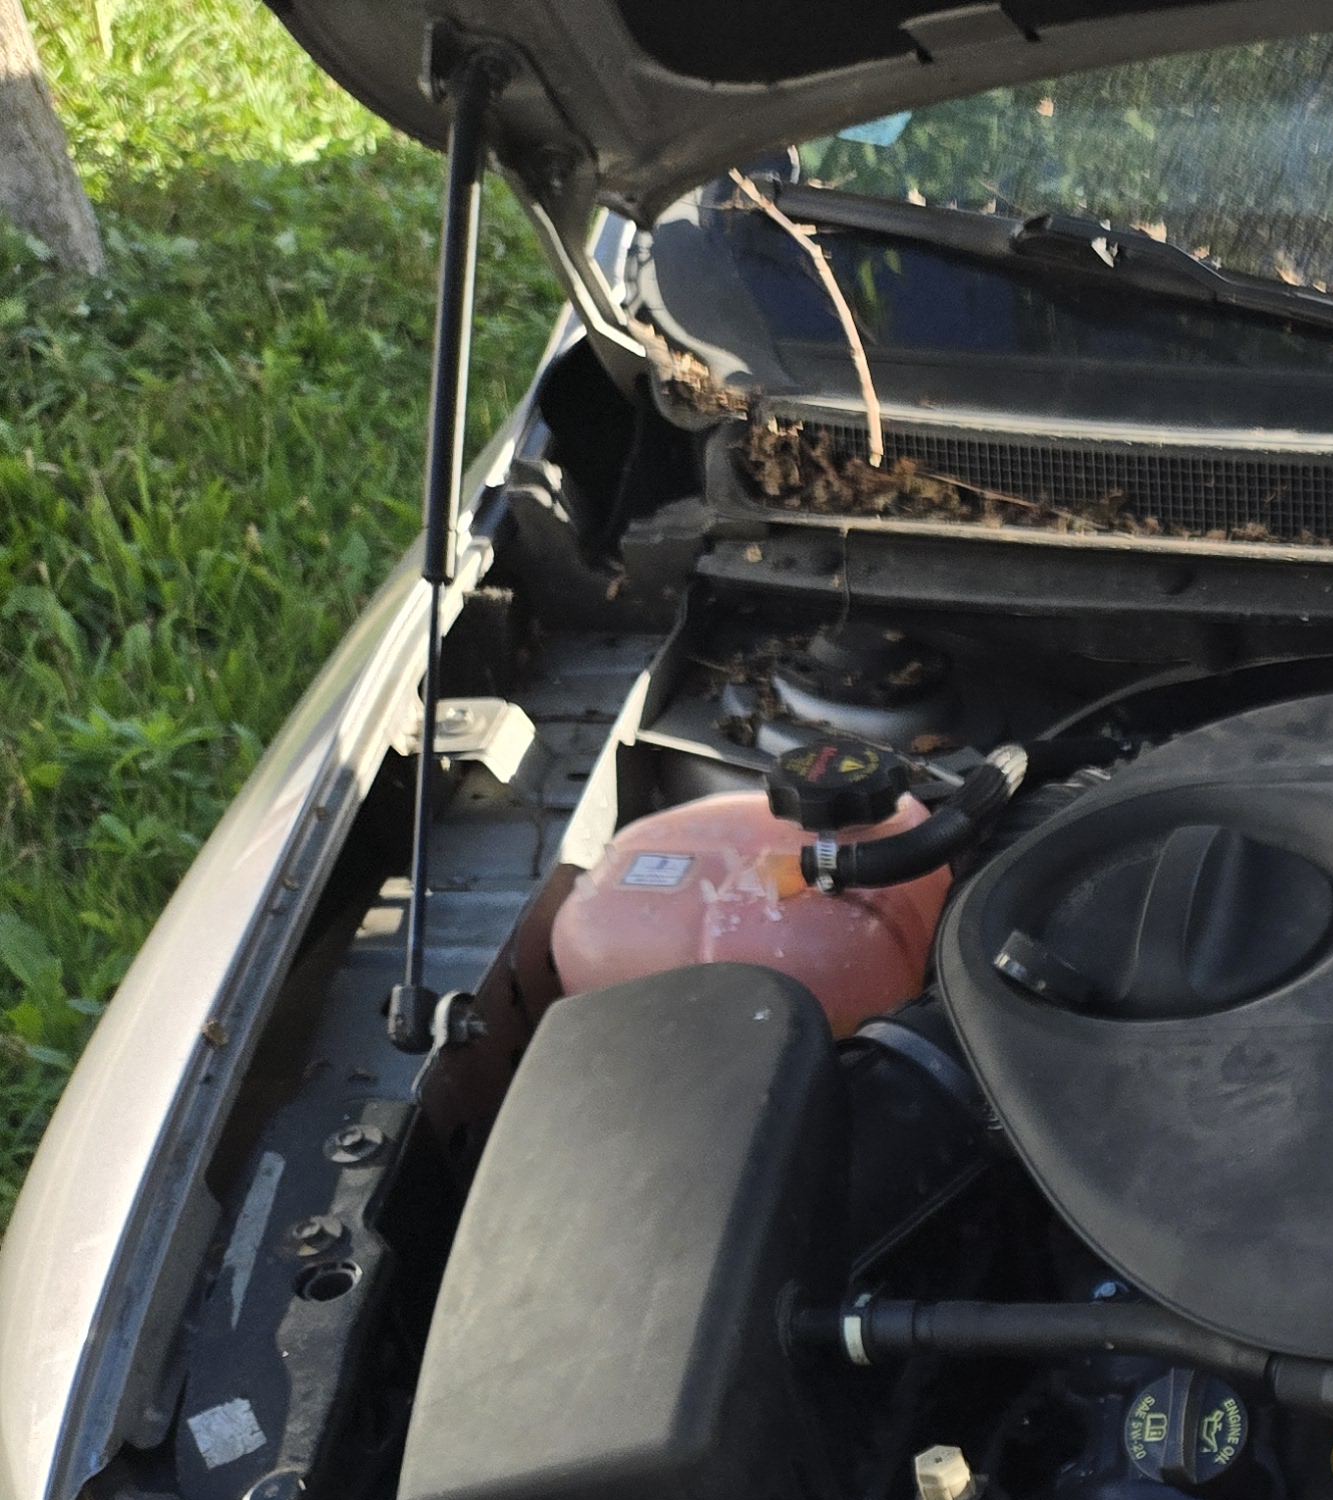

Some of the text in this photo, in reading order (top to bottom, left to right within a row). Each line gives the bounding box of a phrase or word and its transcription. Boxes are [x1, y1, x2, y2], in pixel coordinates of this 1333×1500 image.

[1131, 1395, 1155, 1460] SAE 5W-20
[1214, 1398, 1241, 1465] ENGINE OIL
